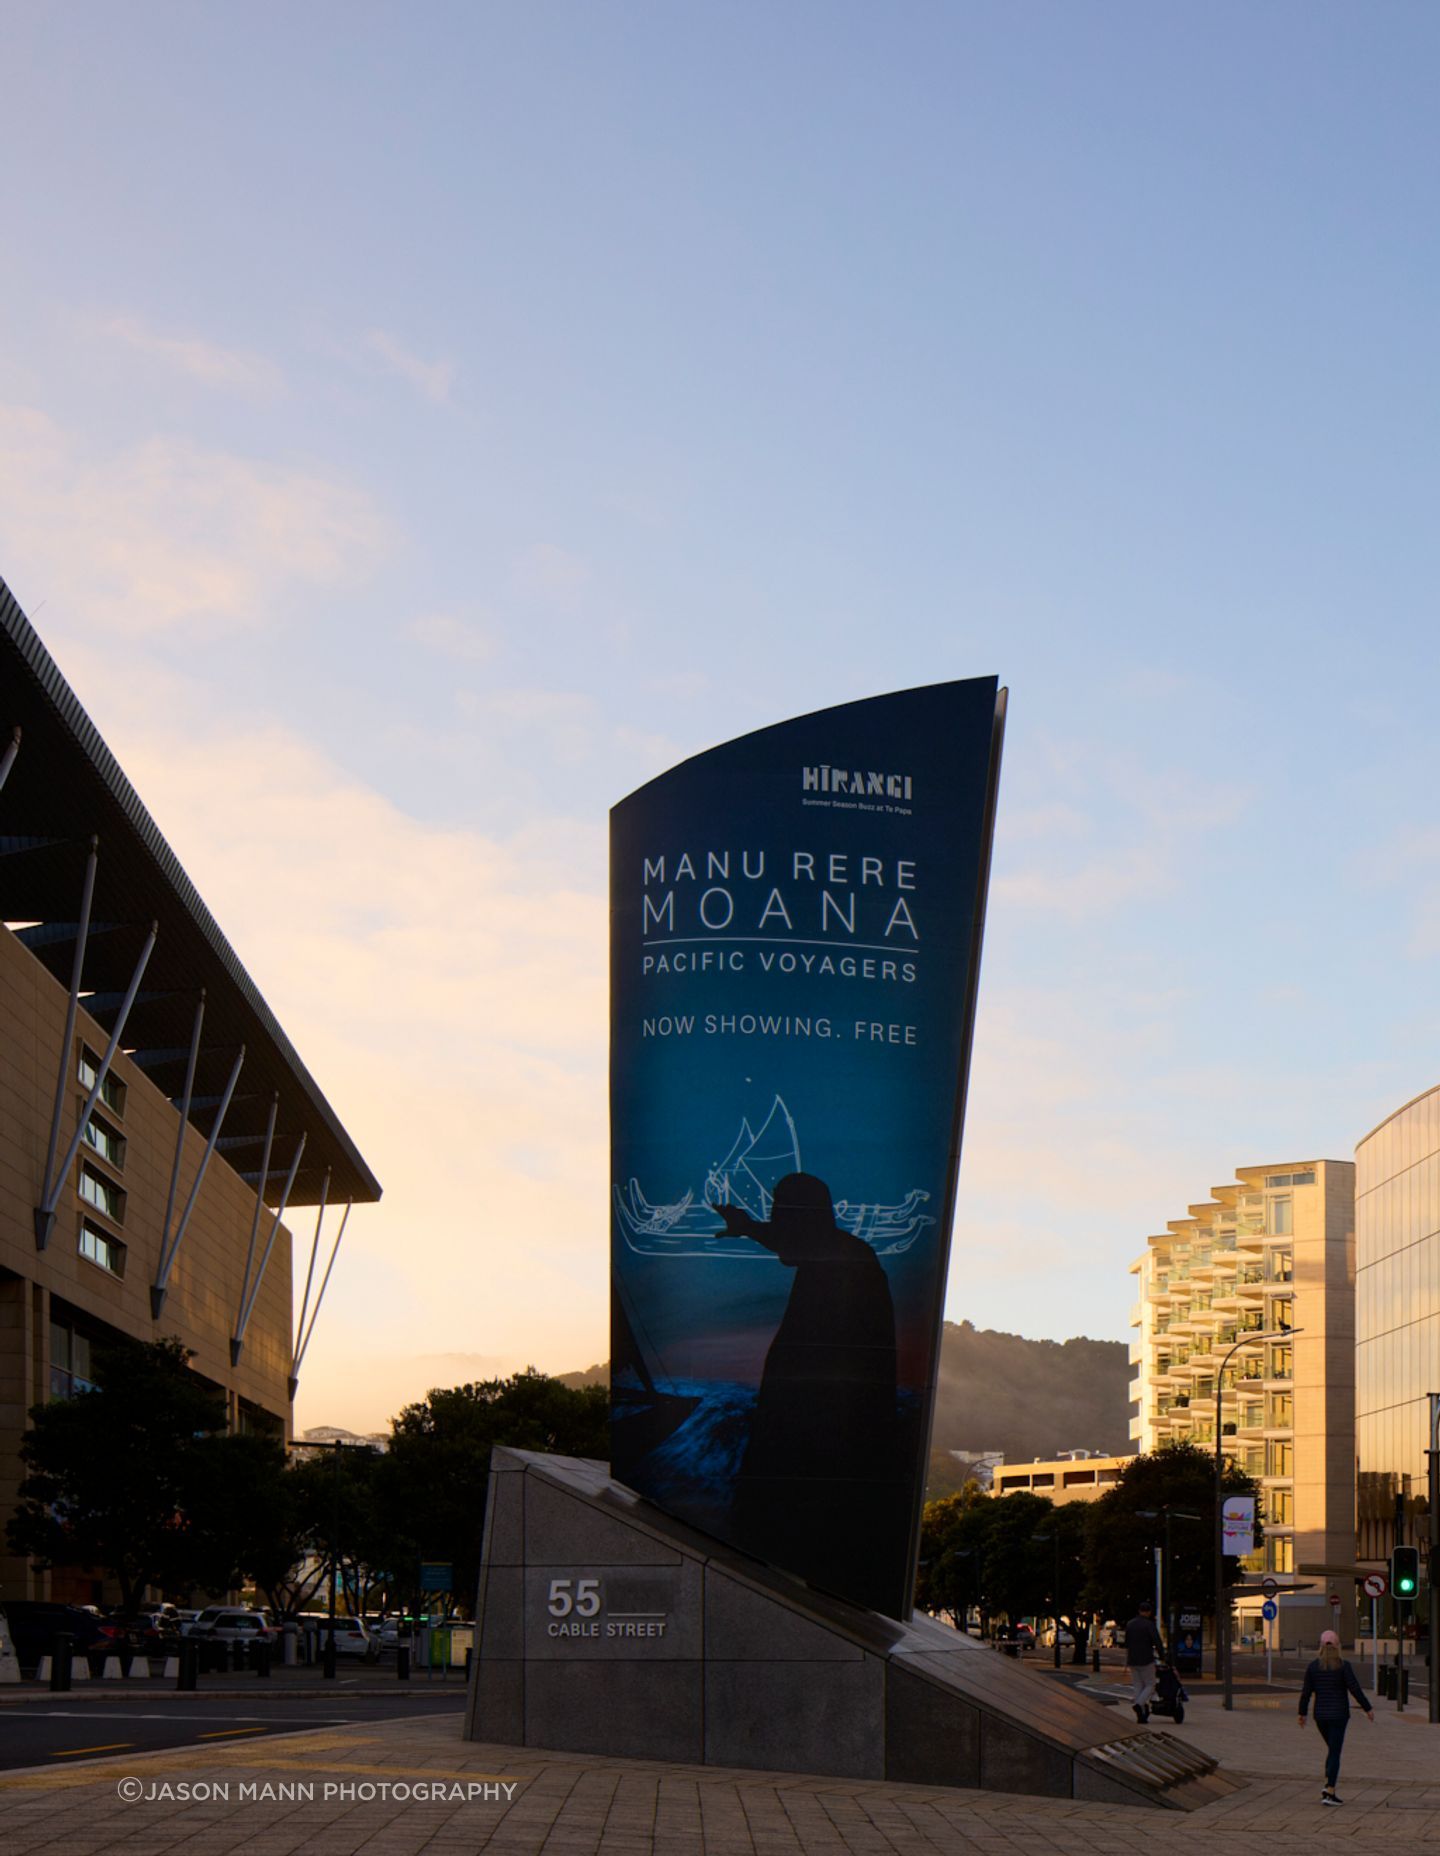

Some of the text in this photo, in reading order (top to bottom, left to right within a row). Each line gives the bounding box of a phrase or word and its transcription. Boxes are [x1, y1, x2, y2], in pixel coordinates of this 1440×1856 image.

[802, 798, 830, 806] Summer
[858, 803, 875, 811] Buzz
[885, 805, 894, 813] Te
[894, 806, 912, 816] Papa
[643, 850, 917, 890] MANU RERE
[643, 886, 920, 940] MOANA
[643, 951, 917, 983] PACIFIC VOYAGERS
[642, 1014, 917, 1046] NOW SHOWING. FREE
[547, 1579, 601, 1617] 55
[547, 1622, 666, 1637] CABLE STREET
